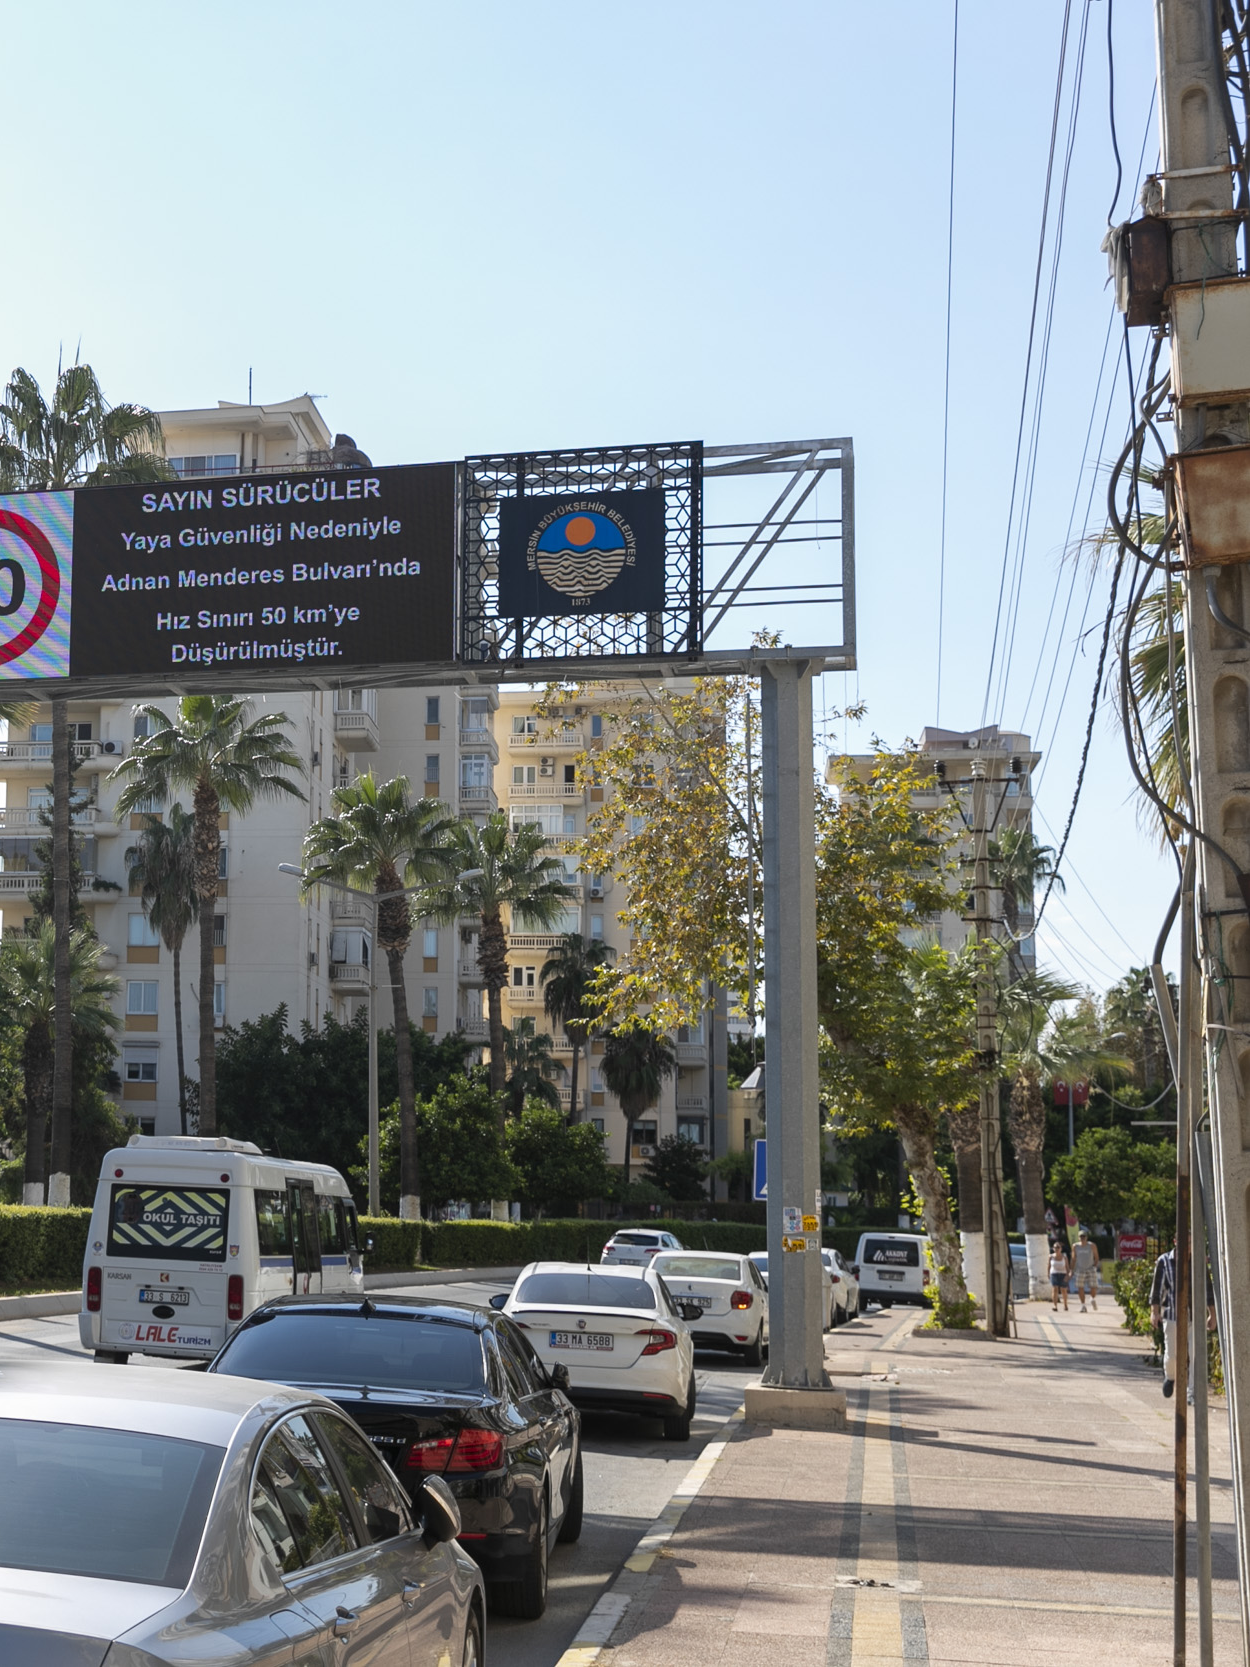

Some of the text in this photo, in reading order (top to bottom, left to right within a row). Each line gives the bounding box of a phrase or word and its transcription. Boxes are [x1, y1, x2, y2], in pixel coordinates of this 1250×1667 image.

[142, 478, 381, 513] SAYIN SÜRÜCÜLER
[121, 516, 402, 553] Yaya Güvenliği Nedeniyle
[526, 530, 542, 571] MERSİN
[538, 501, 607, 530] BÜYÜKŞEHİR
[101, 573, 170, 592] Adnan
[178, 568, 285, 588] Menderes
[571, 598, 591, 606] 1873
[156, 612, 191, 631] Hız
[197, 610, 253, 629] Sınırı
[261, 607, 287, 626] 50
[171, 637, 343, 666] Düşürülmüştür.
[142, 1212, 220, 1227] OKUL TAŞITI
[107, 1271, 132, 1280] KARSAN
[144, 1291, 187, 1303] 33 S 6213
[135, 1325, 179, 1343] LALE
[557, 1333, 568, 1344] 33
[571, 1334, 583, 1345] MA
[587, 1335, 610, 1347] 6588
